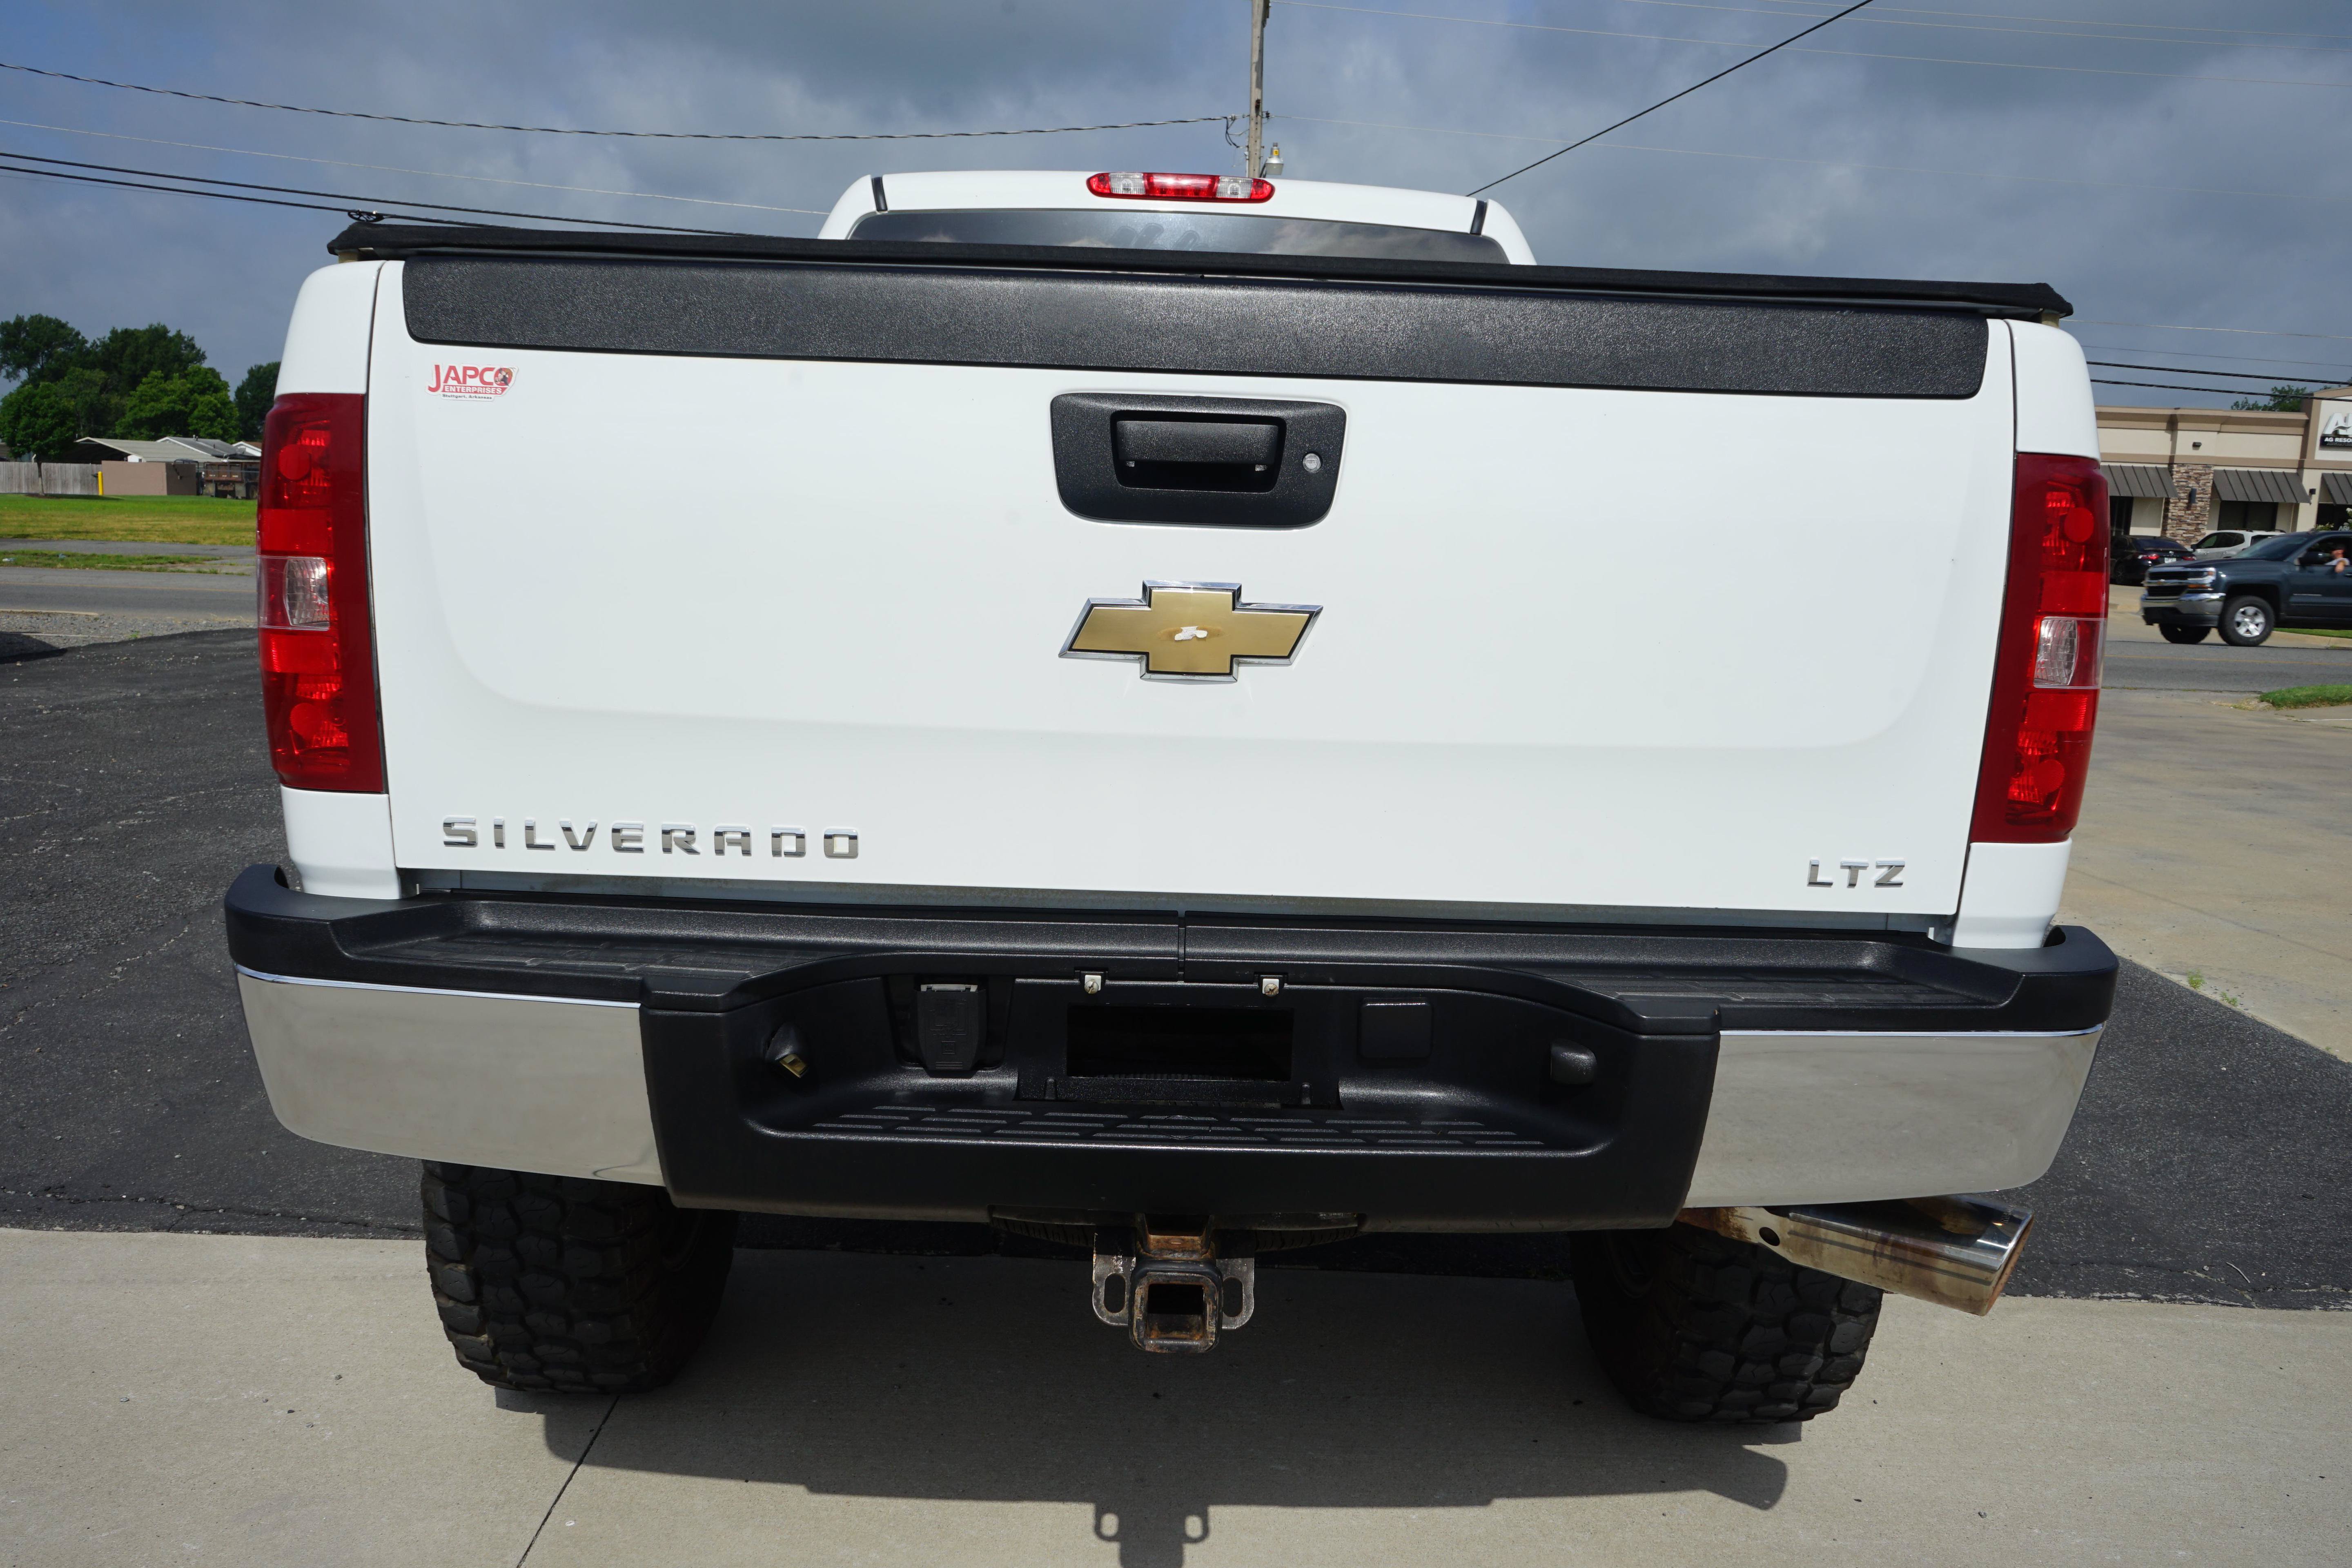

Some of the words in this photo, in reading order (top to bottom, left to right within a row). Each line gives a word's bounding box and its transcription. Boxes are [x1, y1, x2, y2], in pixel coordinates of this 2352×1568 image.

[428, 364, 513, 392] JAPCO
[445, 386, 502, 394] ENTERPRISES
[442, 816, 860, 858] SILVERADO
[1807, 859, 1905, 887] LTZ
